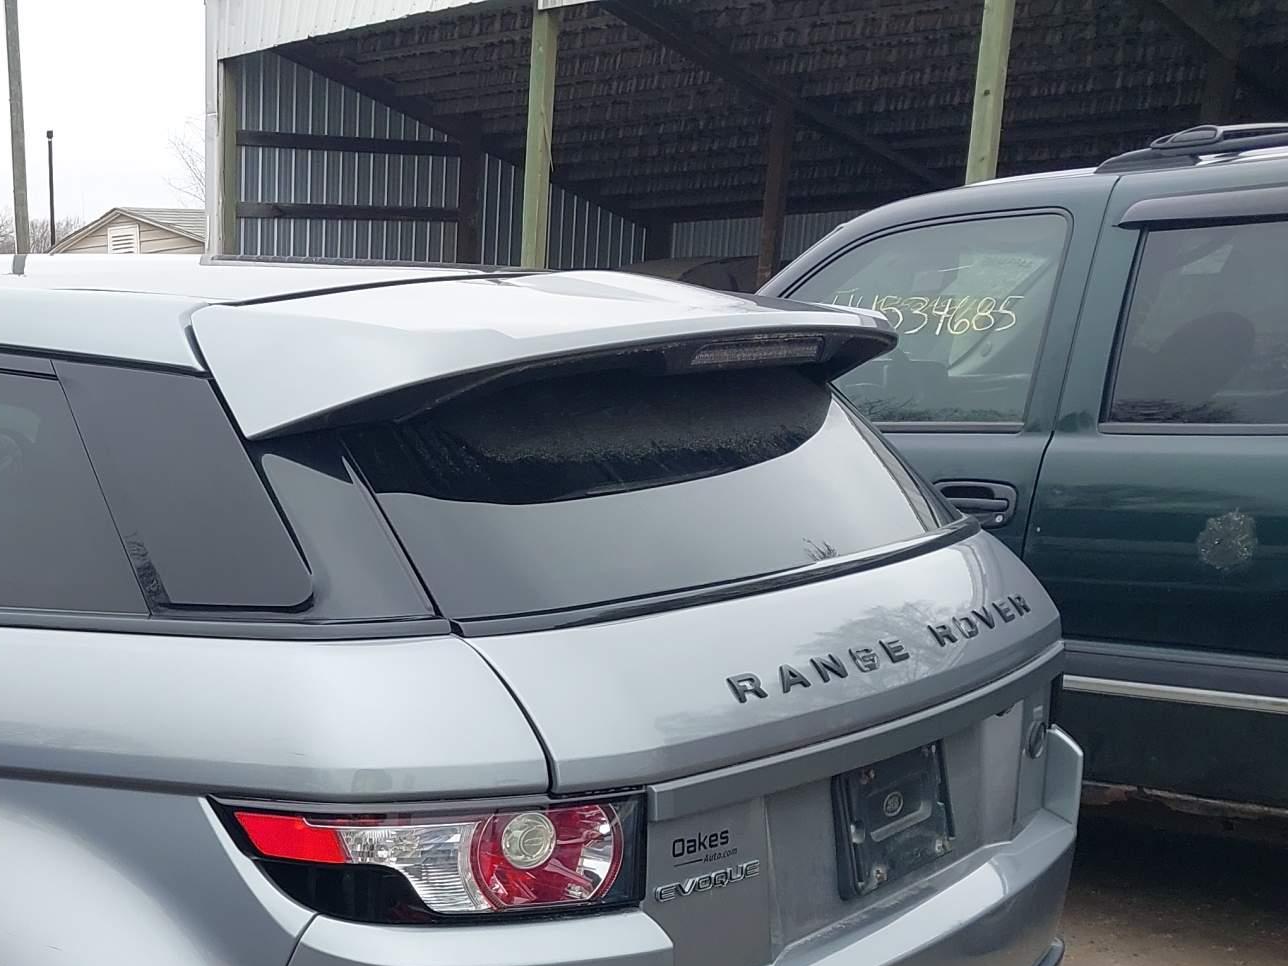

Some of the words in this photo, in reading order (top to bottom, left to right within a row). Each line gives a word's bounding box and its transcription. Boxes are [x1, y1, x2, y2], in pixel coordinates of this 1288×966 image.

[726, 639, 911, 704] RANGE
[927, 592, 1032, 648] ROVER
[672, 829, 730, 858] Oakes
[703, 848, 738, 863] Auto.com
[655, 860, 760, 902] EVOQUE
